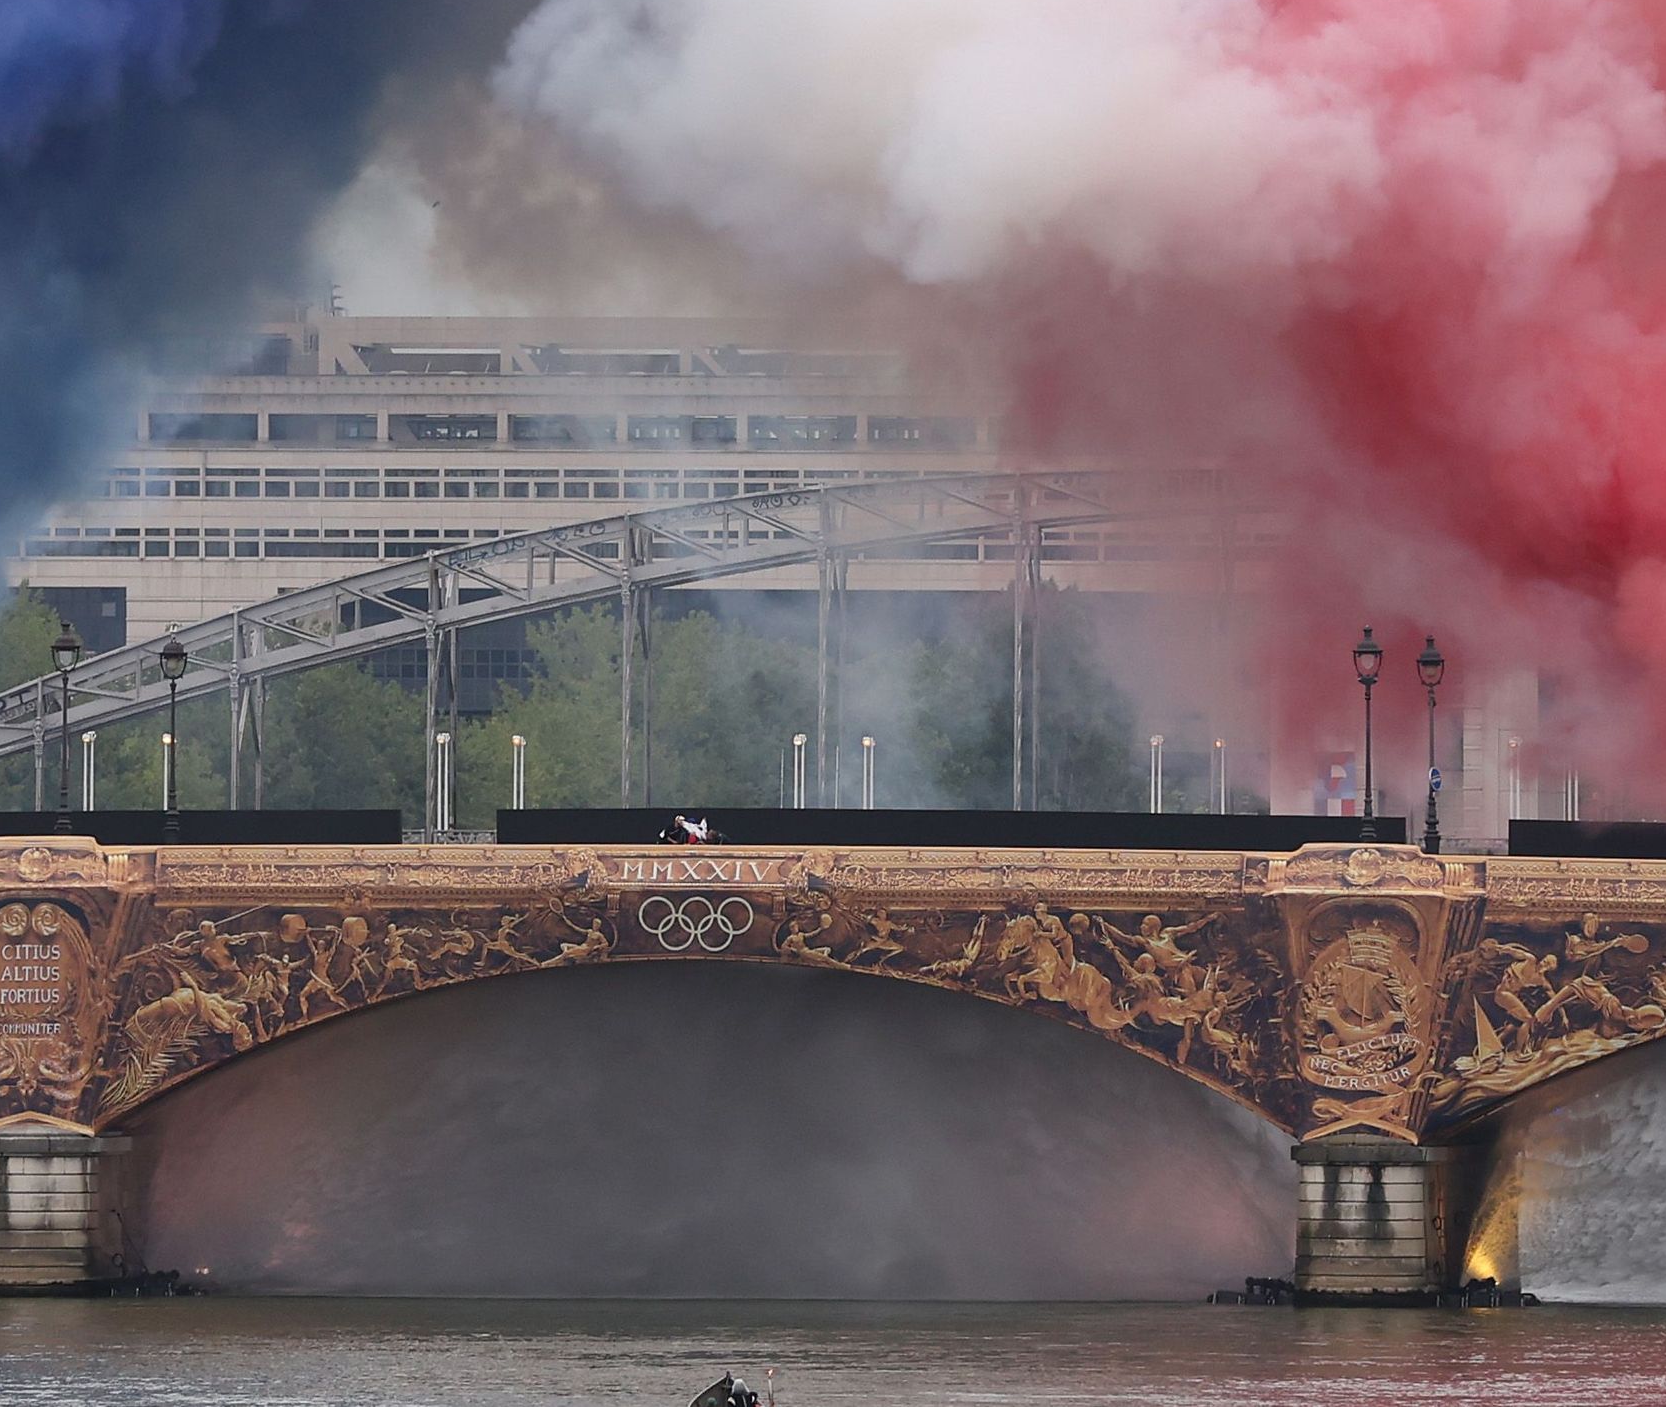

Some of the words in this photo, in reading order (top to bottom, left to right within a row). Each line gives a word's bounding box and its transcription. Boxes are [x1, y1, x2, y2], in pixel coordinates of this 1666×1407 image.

[621, 861, 774, 882] MMXXIV
[2, 945, 61, 960] CITIUS
[1, 965, 61, 982] ALTIUS
[0, 988, 60, 1004] FORTIUS
[1336, 1034, 1420, 1060] FLUCTUAT
[1310, 1057, 1339, 1073] NEC
[1324, 1066, 1411, 1088] MERGITUR
